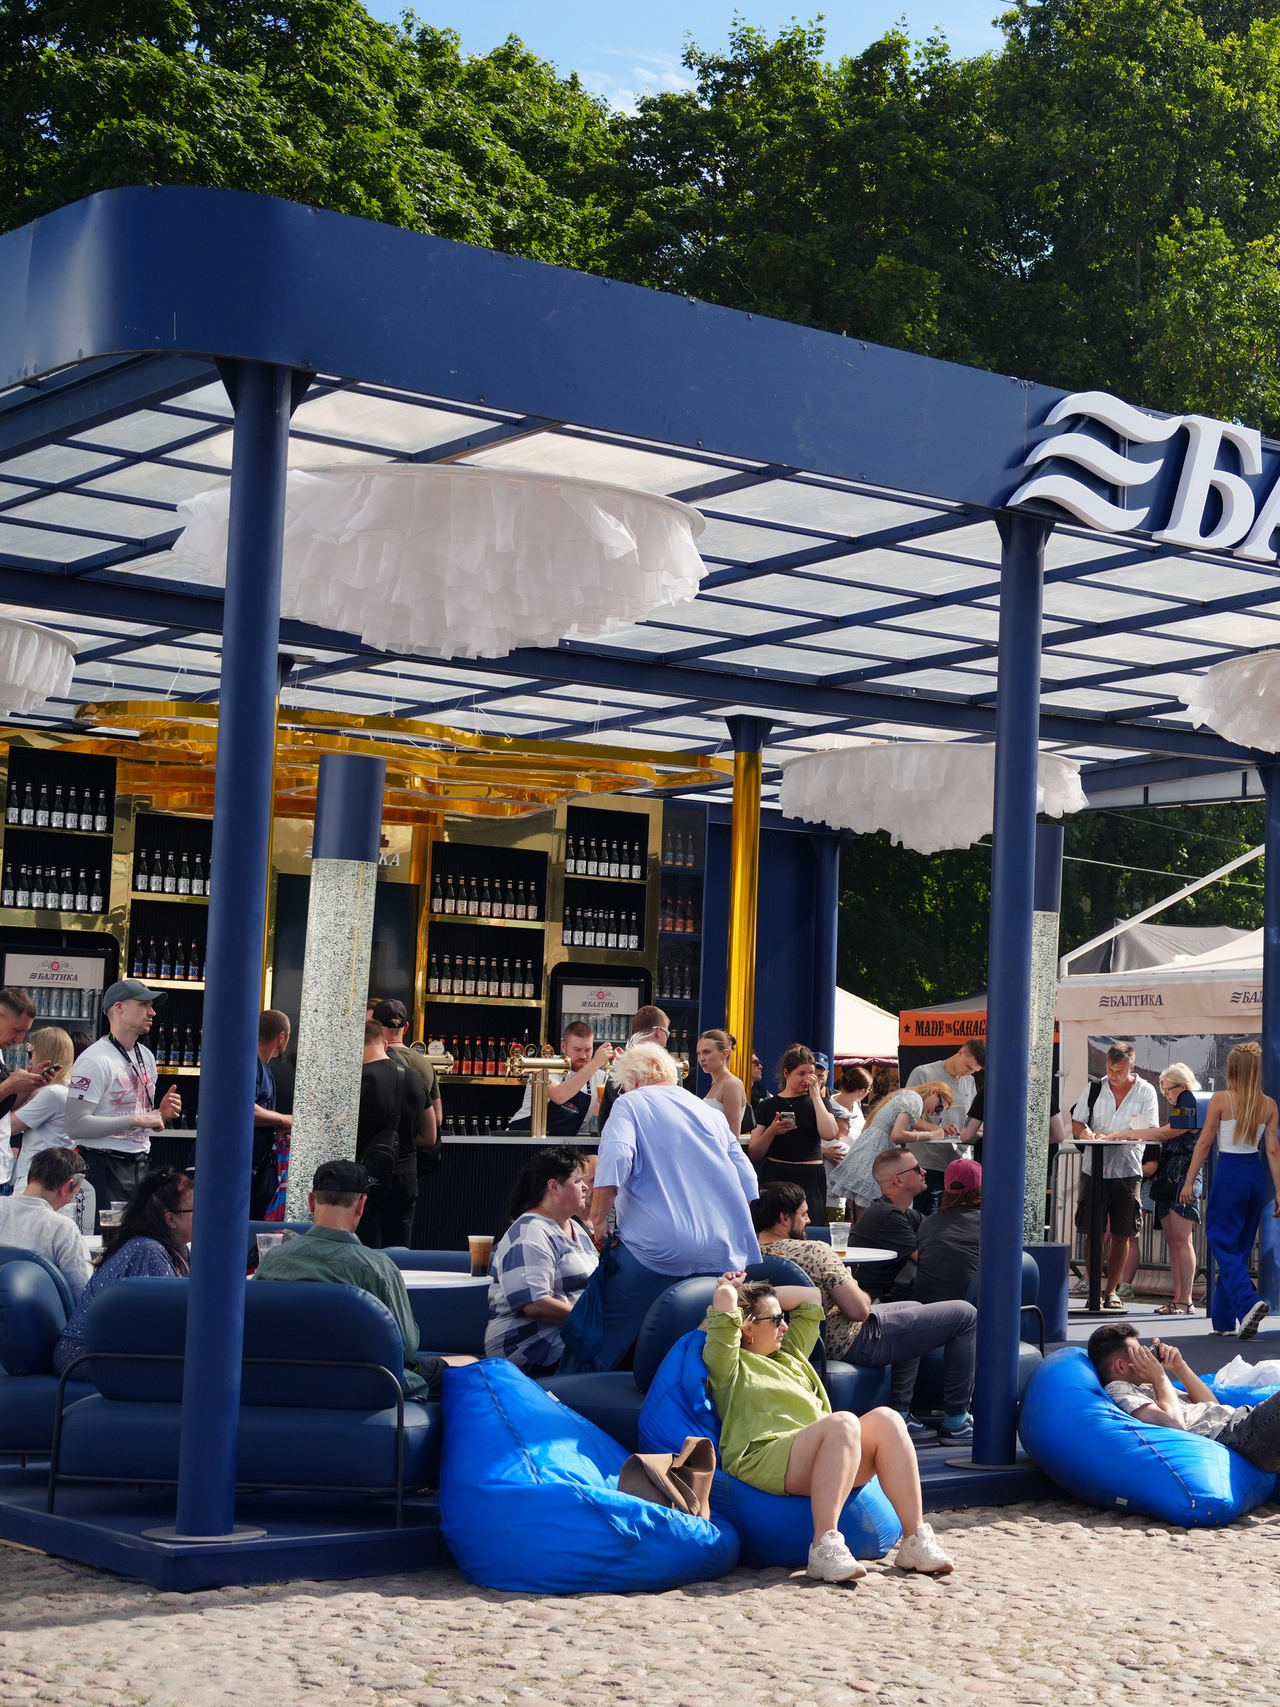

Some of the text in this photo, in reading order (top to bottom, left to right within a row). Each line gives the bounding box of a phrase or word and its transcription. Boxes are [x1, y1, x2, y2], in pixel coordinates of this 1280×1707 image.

[37, 973, 78, 981] БАЛТИКА
[1110, 994, 1163, 1008] БАЛТИКА
[915, 1020, 988, 1036] MADE IN GARAG
